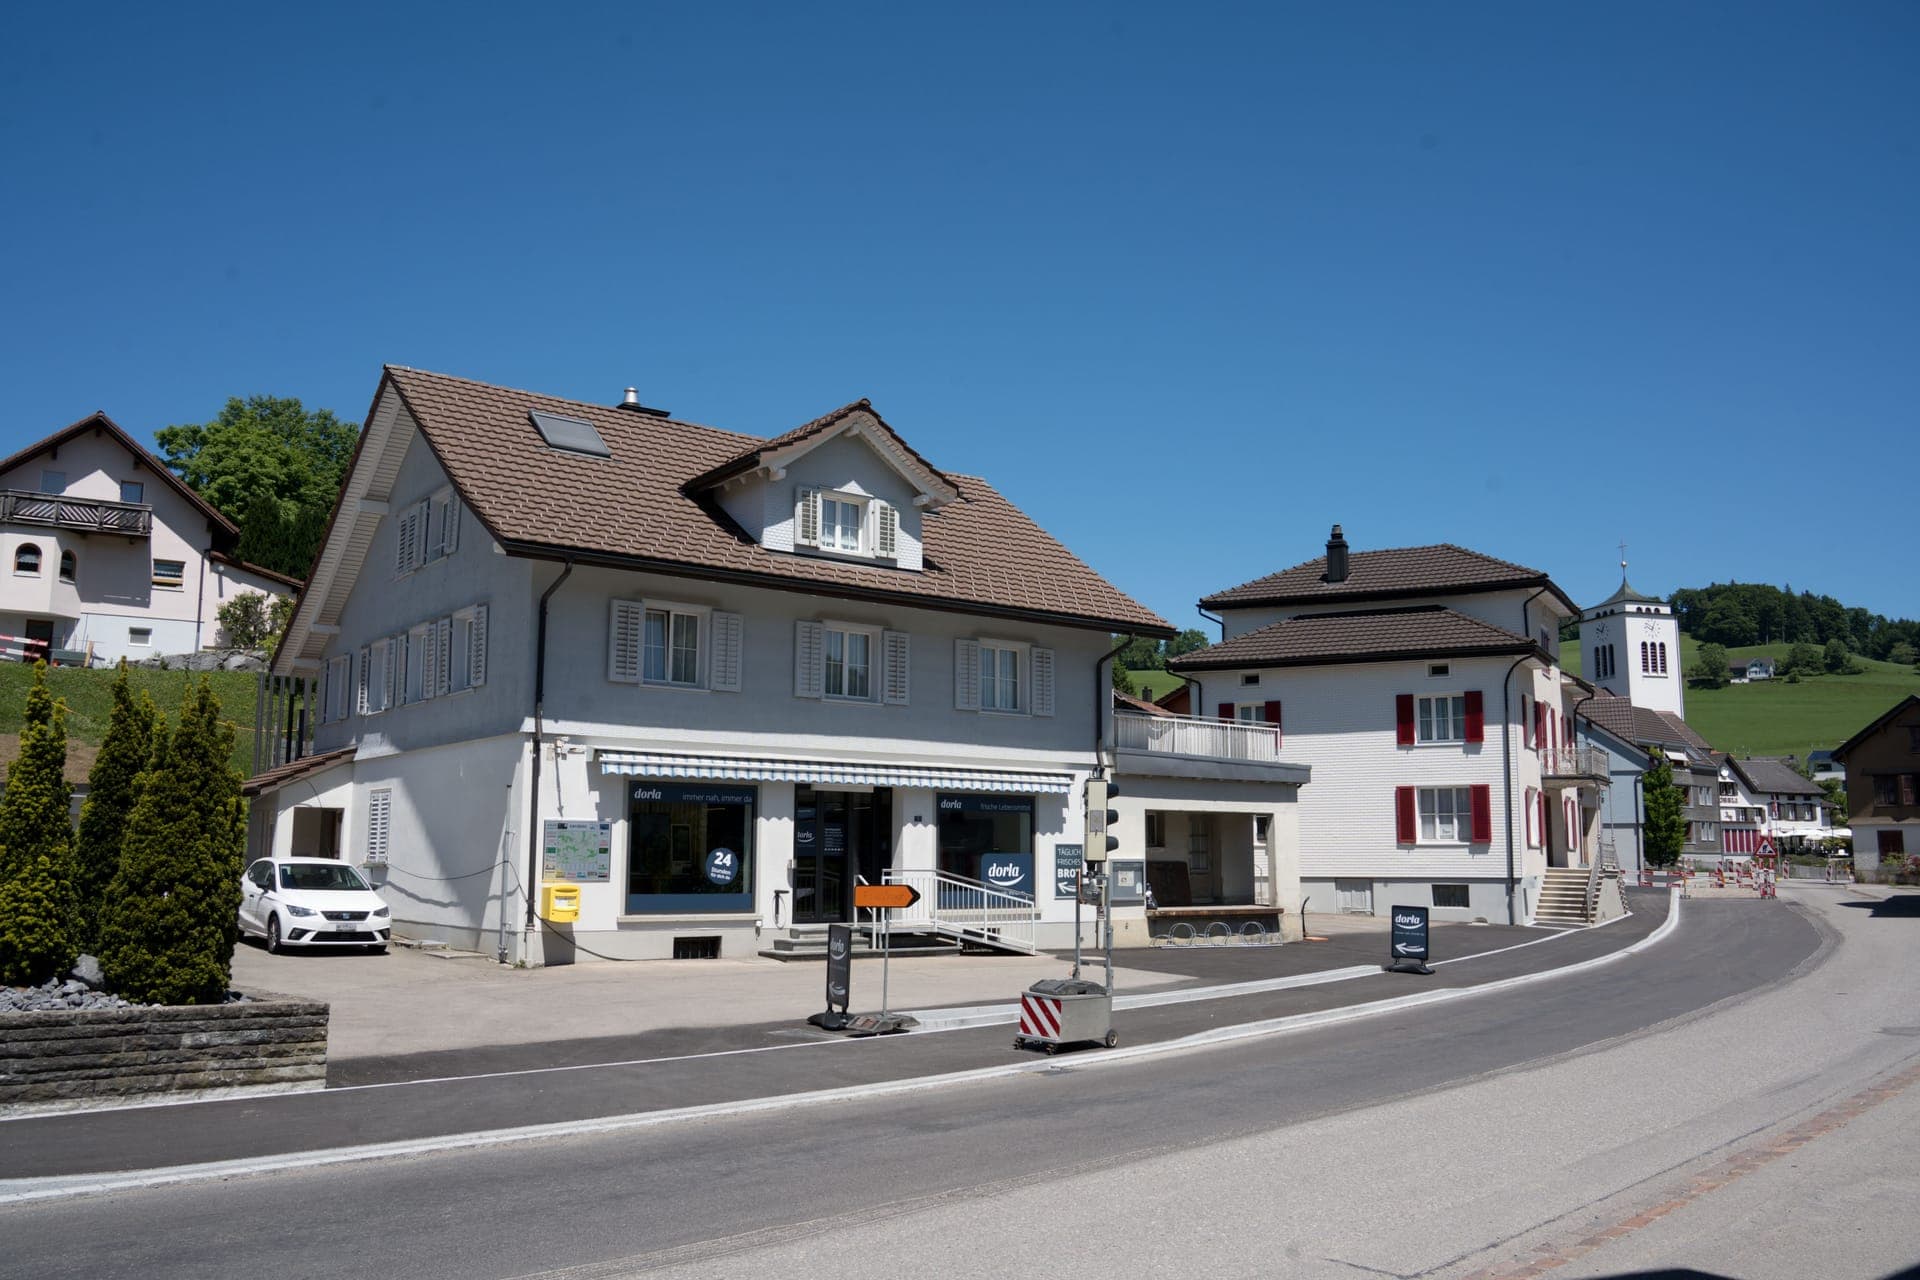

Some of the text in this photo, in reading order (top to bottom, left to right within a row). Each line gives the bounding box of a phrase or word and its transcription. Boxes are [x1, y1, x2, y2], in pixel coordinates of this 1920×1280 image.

[634, 788, 662, 800] dorla
[682, 792, 704, 801] immer
[721, 793, 742, 802] immer
[940, 799, 962, 809] dorla
[1057, 847, 1082, 856] TÄGLICH
[714, 851, 732, 867] 24
[1057, 858, 1082, 866] FRISCHES
[988, 862, 1020, 877] dorla
[1395, 914, 1420, 924] dorla
